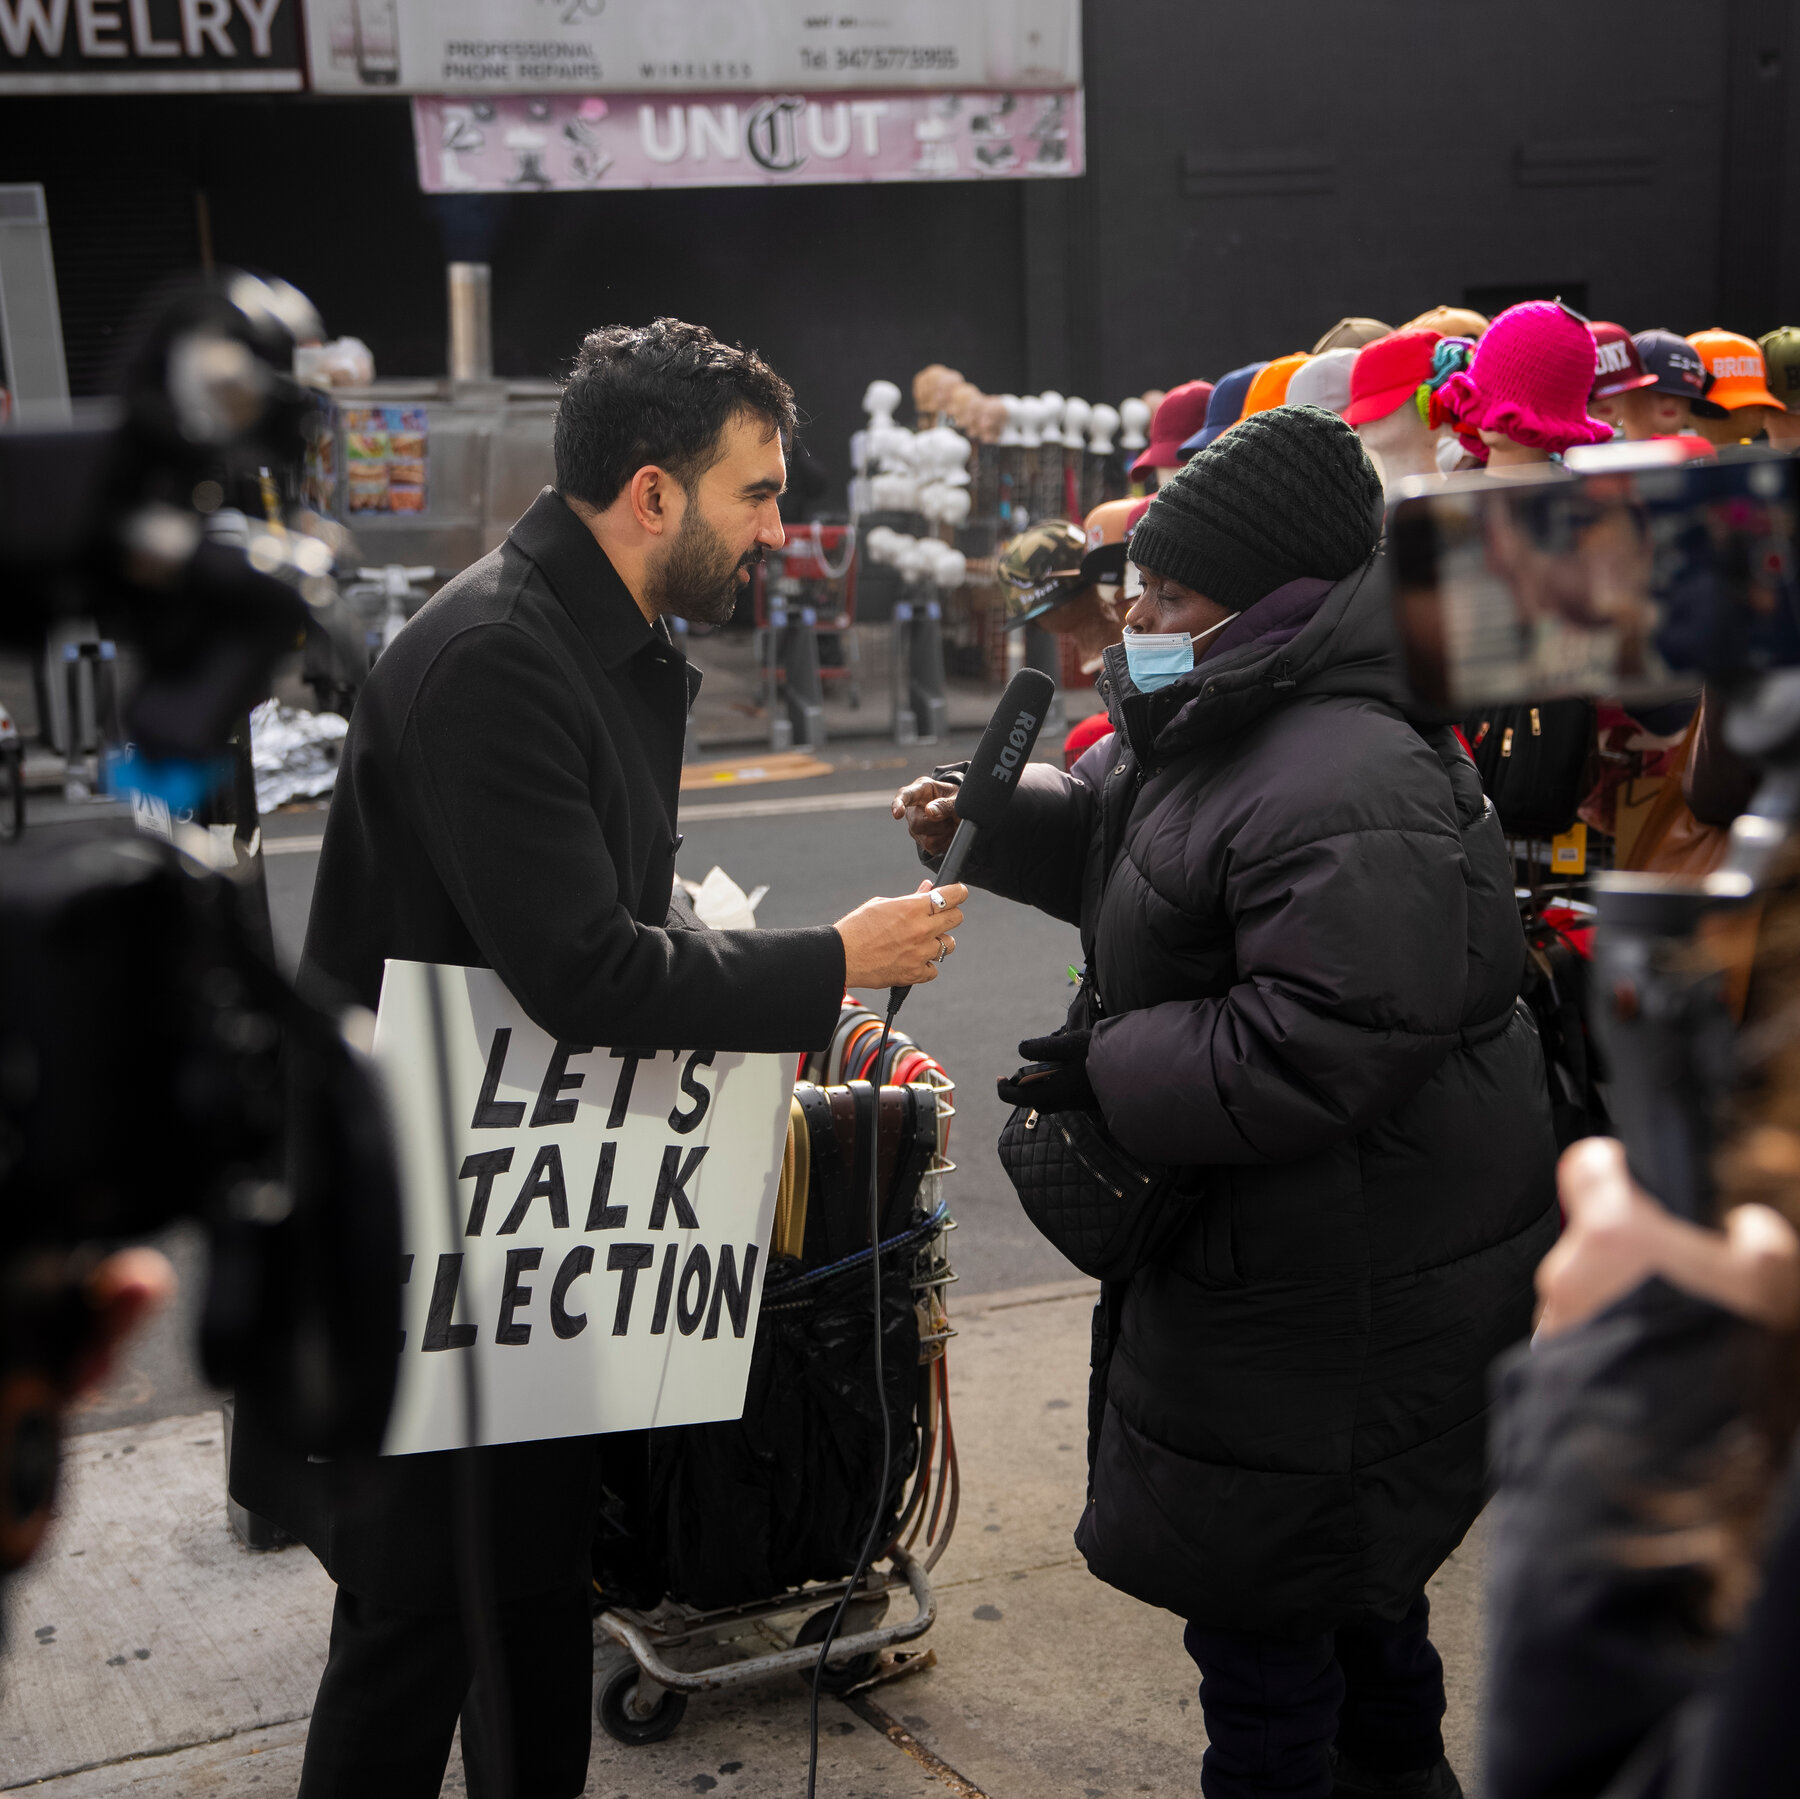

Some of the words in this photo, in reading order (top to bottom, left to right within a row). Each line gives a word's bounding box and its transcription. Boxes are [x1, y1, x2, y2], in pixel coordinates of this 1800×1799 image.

[0, 0, 283, 58] WELRY
[445, 40, 595, 60] PROFESSIONAL
[443, 61, 510, 80] PHONE
[516, 61, 603, 81] REPAIRS
[640, 61, 752, 79] WIRELESS
[637, 96, 889, 174] UNCUT
[1594, 340, 1632, 376] ONX
[470, 1027, 717, 1135] LET'S
[458, 1141, 710, 1237] TALK
